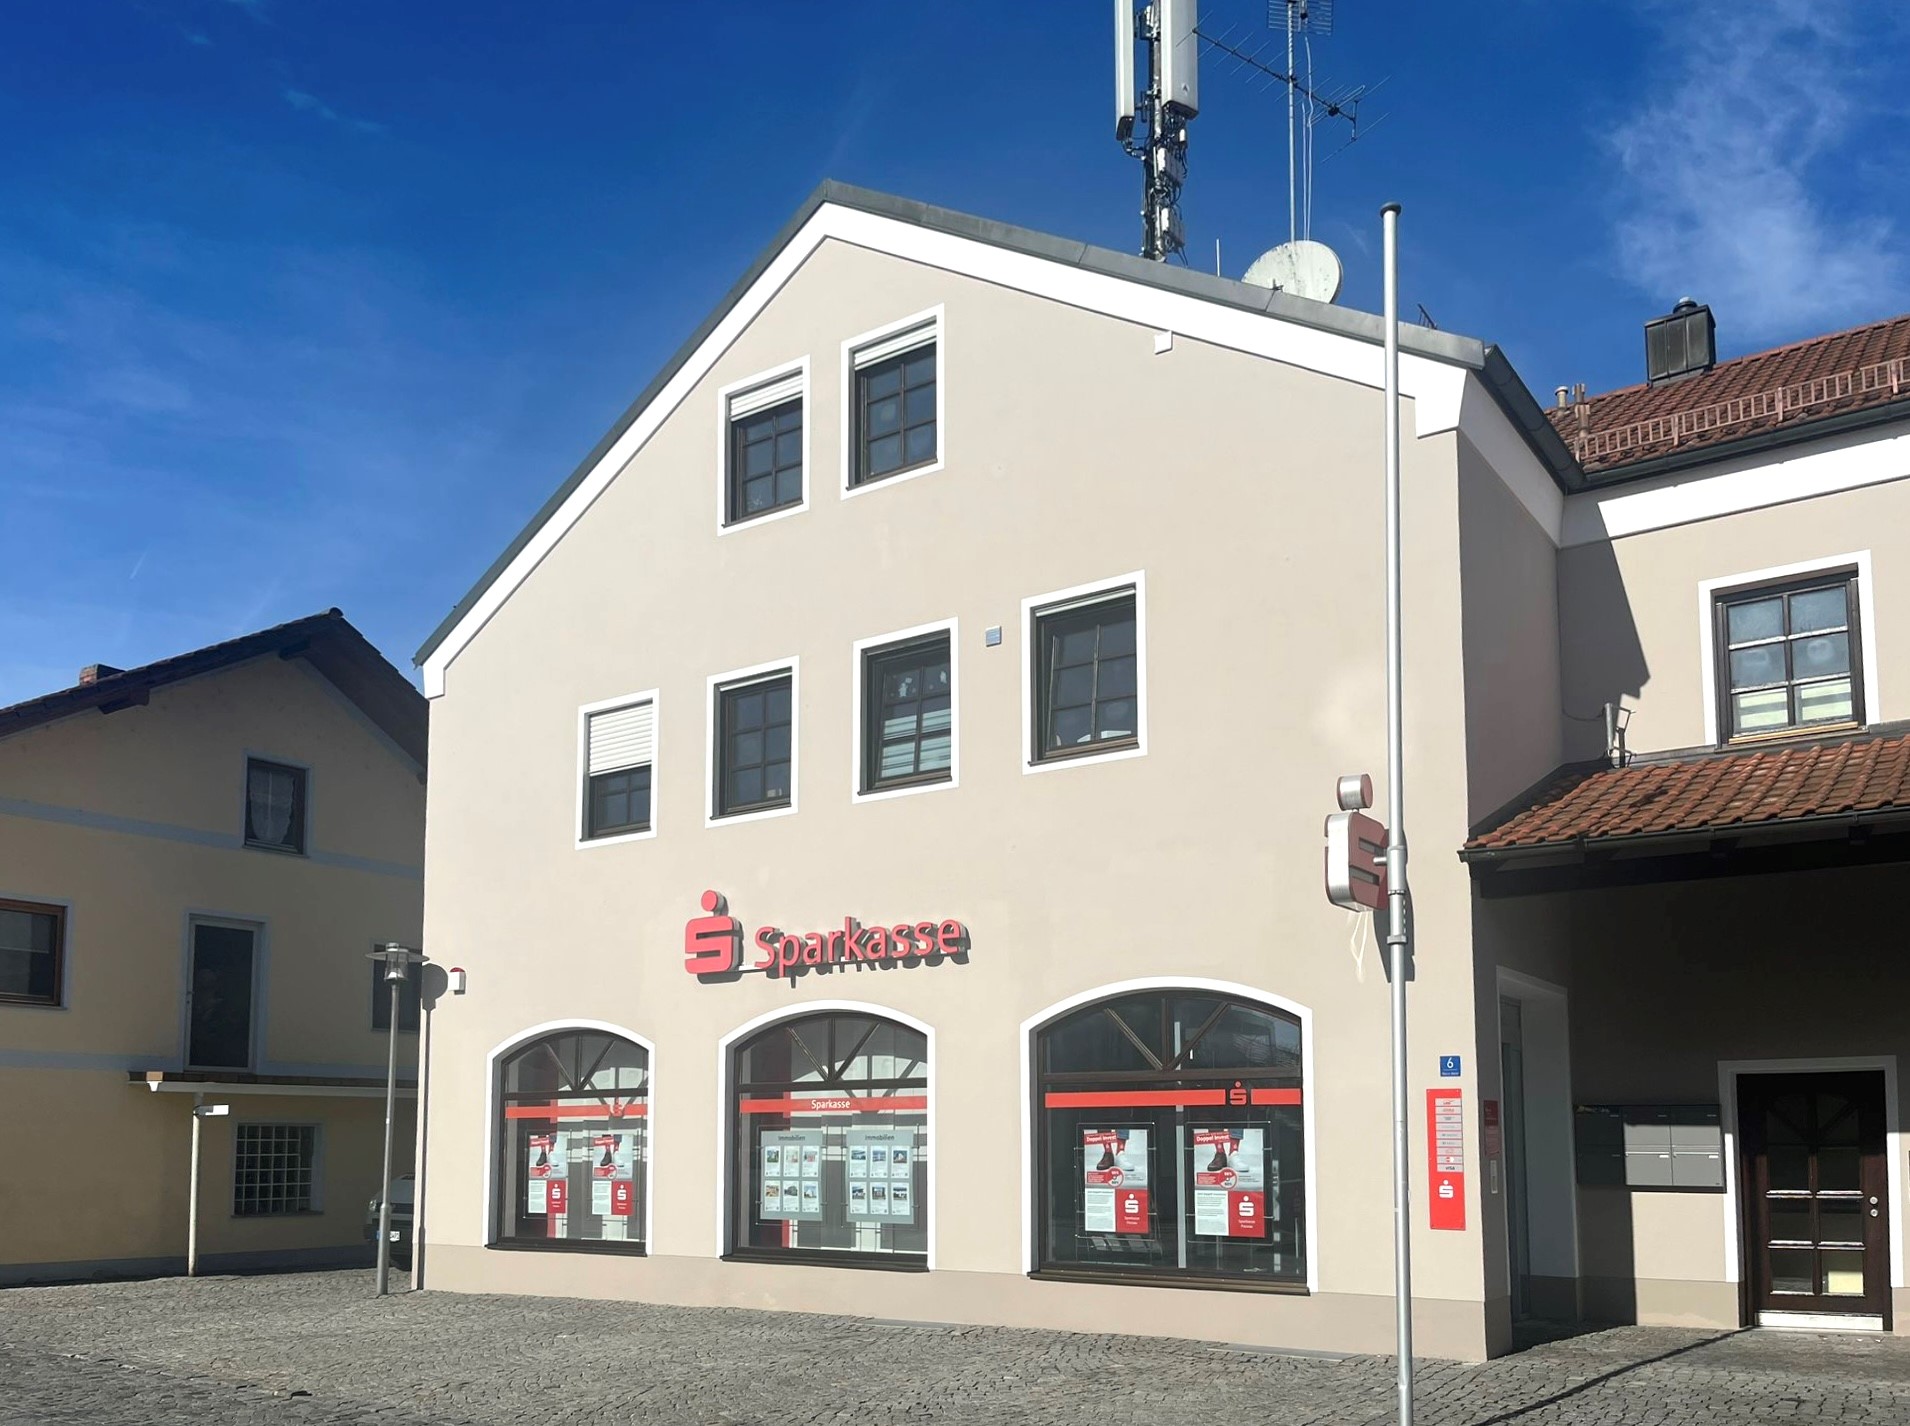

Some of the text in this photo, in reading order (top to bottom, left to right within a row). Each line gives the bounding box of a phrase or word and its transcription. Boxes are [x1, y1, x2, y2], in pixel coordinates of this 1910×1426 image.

[755, 916, 964, 978] Sparkasse
[1446, 1057, 1454, 1069] 6
[811, 1100, 851, 1110] Sparkasse
